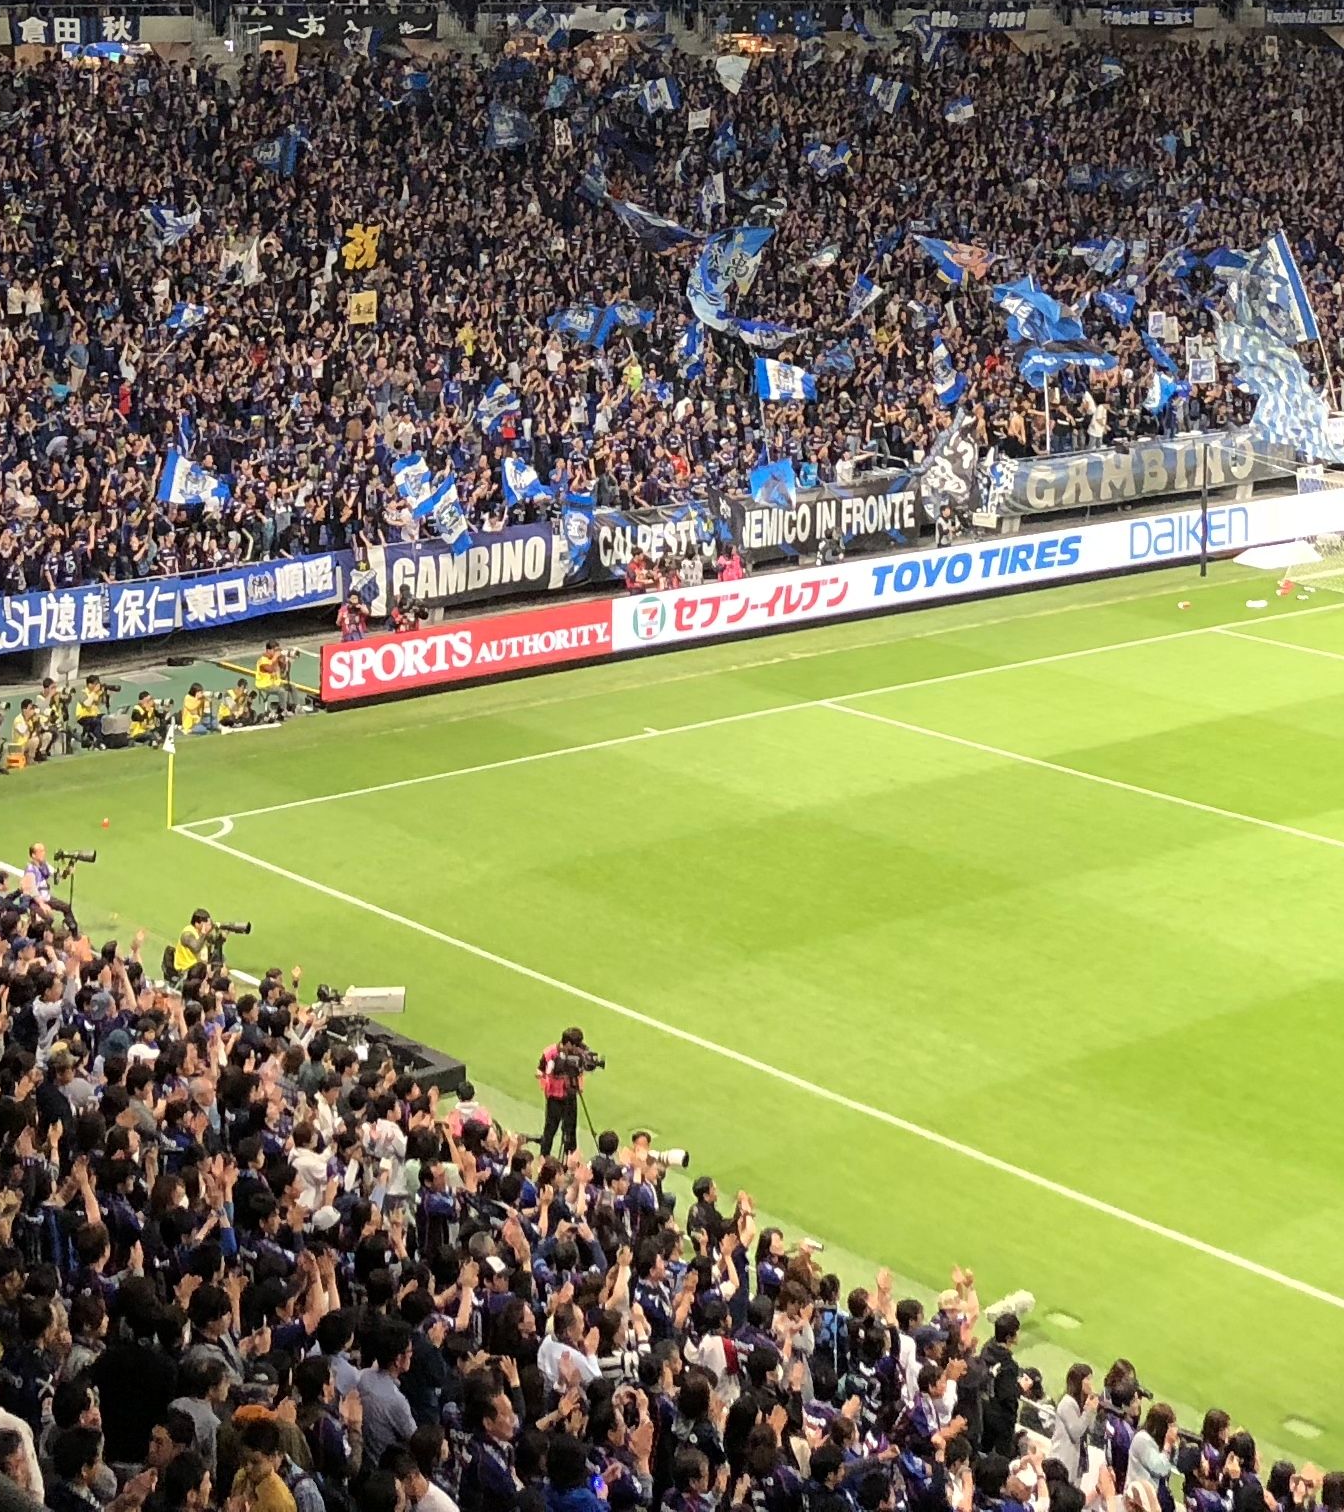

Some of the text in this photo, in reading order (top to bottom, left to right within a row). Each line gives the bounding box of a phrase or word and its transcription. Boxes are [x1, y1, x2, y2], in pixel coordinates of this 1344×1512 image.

[18, 15, 132, 44] 倉田 秋
[341, 222, 382, 270] 祝
[1026, 437, 1255, 510] GAMBINO
[815, 500, 838, 540] IN
[840, 490, 916, 536] FRONTE
[183, 577, 248, 623] 東口
[274, 557, 335, 603] 順昭
[393, 535, 546, 600] GAMBINO
[871, 535, 1083, 596] TOYO TIRES
[329, 629, 473, 690] SPORTS
